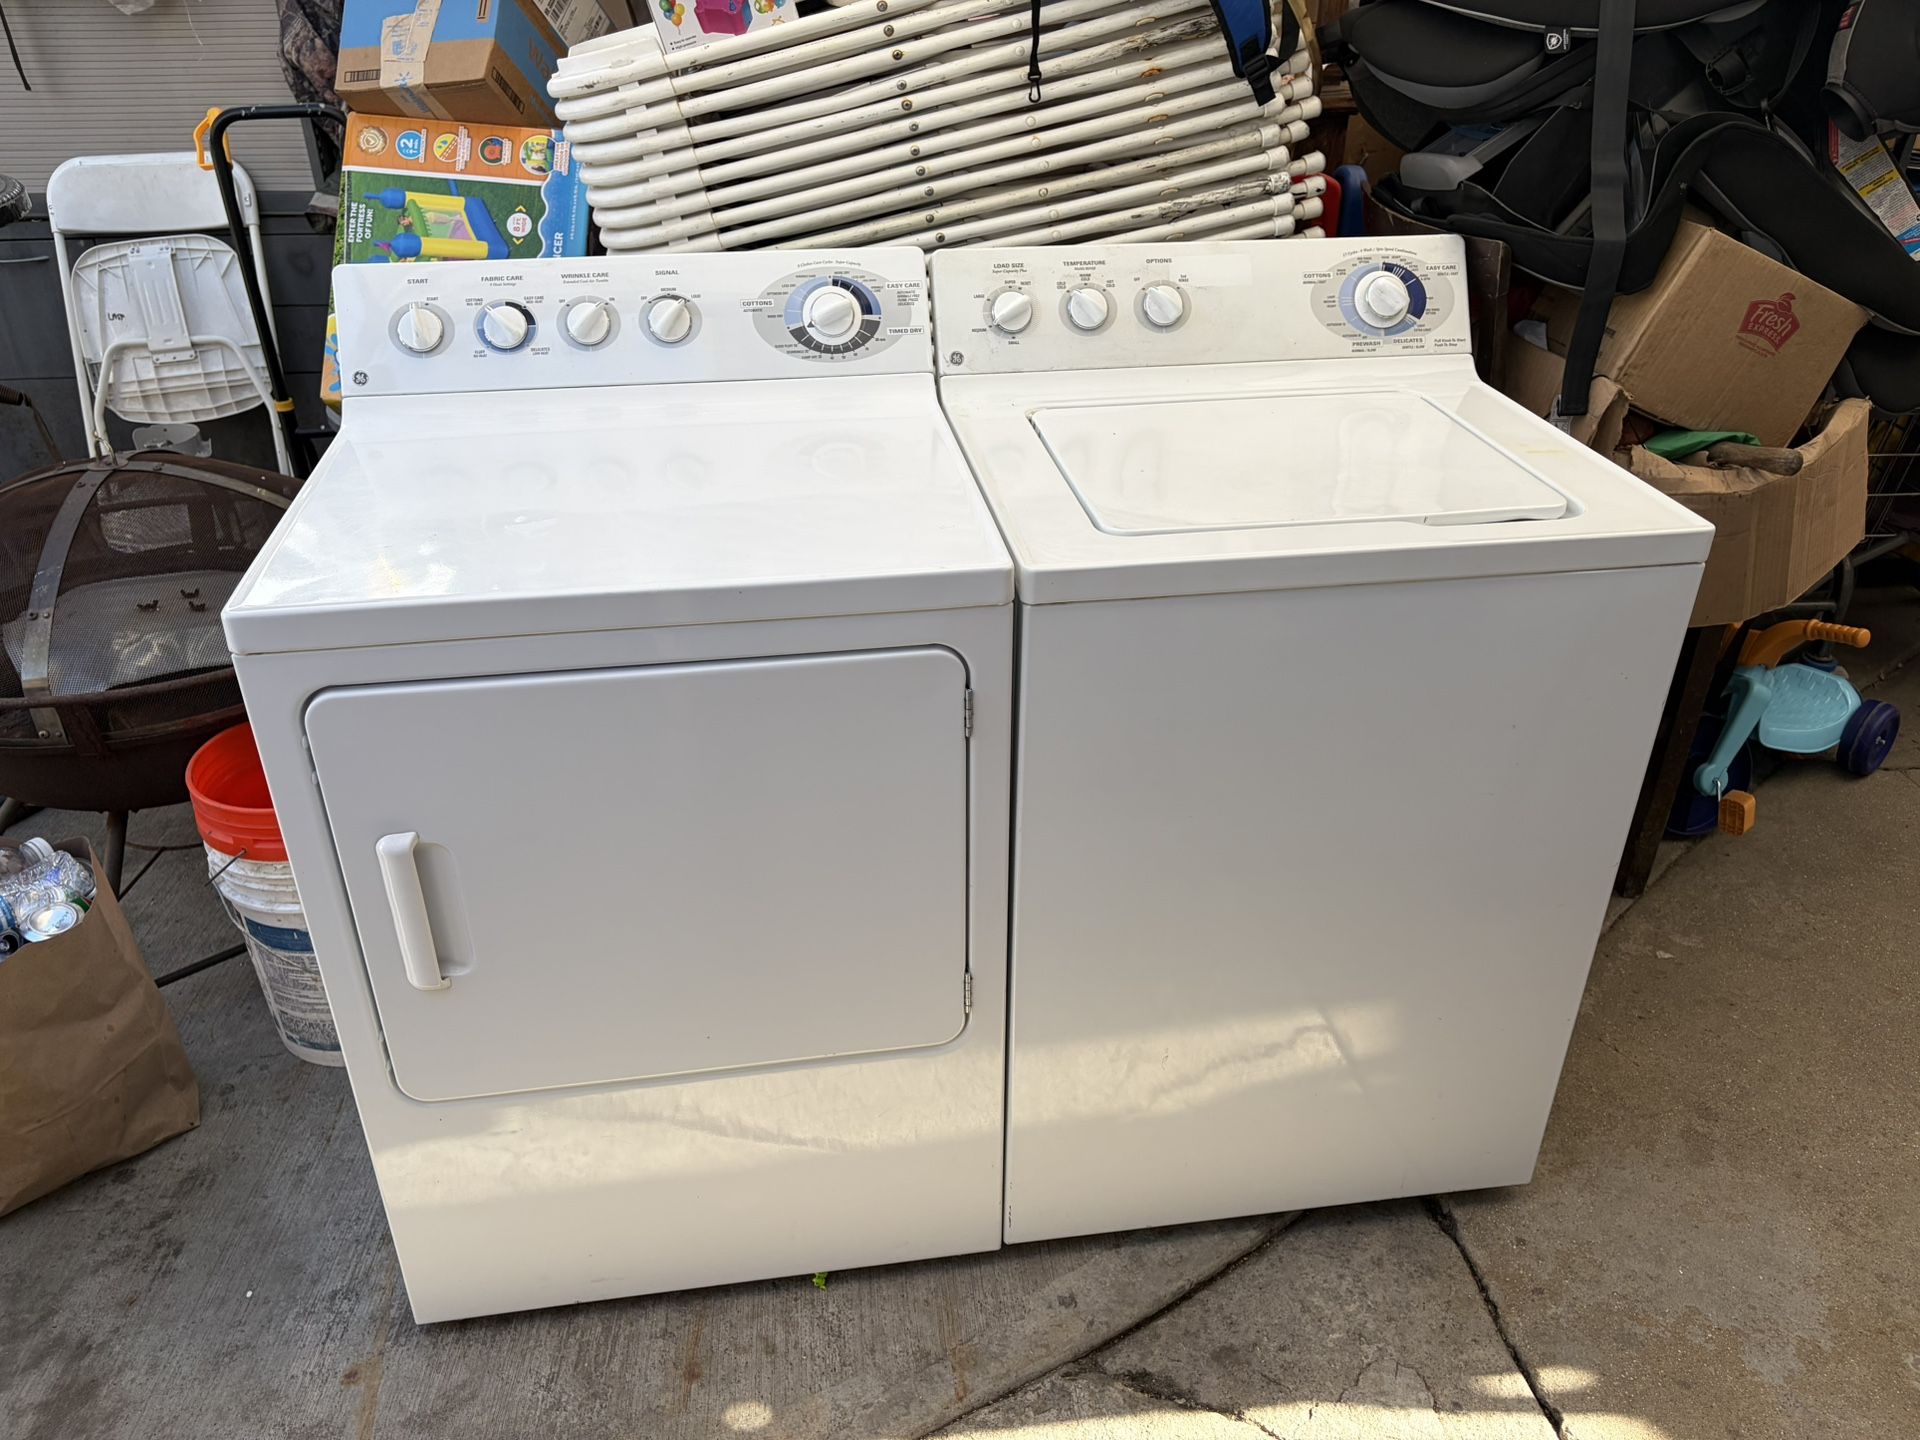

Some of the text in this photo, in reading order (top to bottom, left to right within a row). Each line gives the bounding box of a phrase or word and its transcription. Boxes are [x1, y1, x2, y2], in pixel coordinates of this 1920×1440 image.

[400, 138, 413, 148] 2
[348, 218, 356, 242] ENTER
[356, 204, 366, 242] FORTRESS
[364, 208, 374, 239] OF FUN!
[1747, 322, 1782, 344] EXPRESS
[1750, 304, 1792, 337] Fresh
